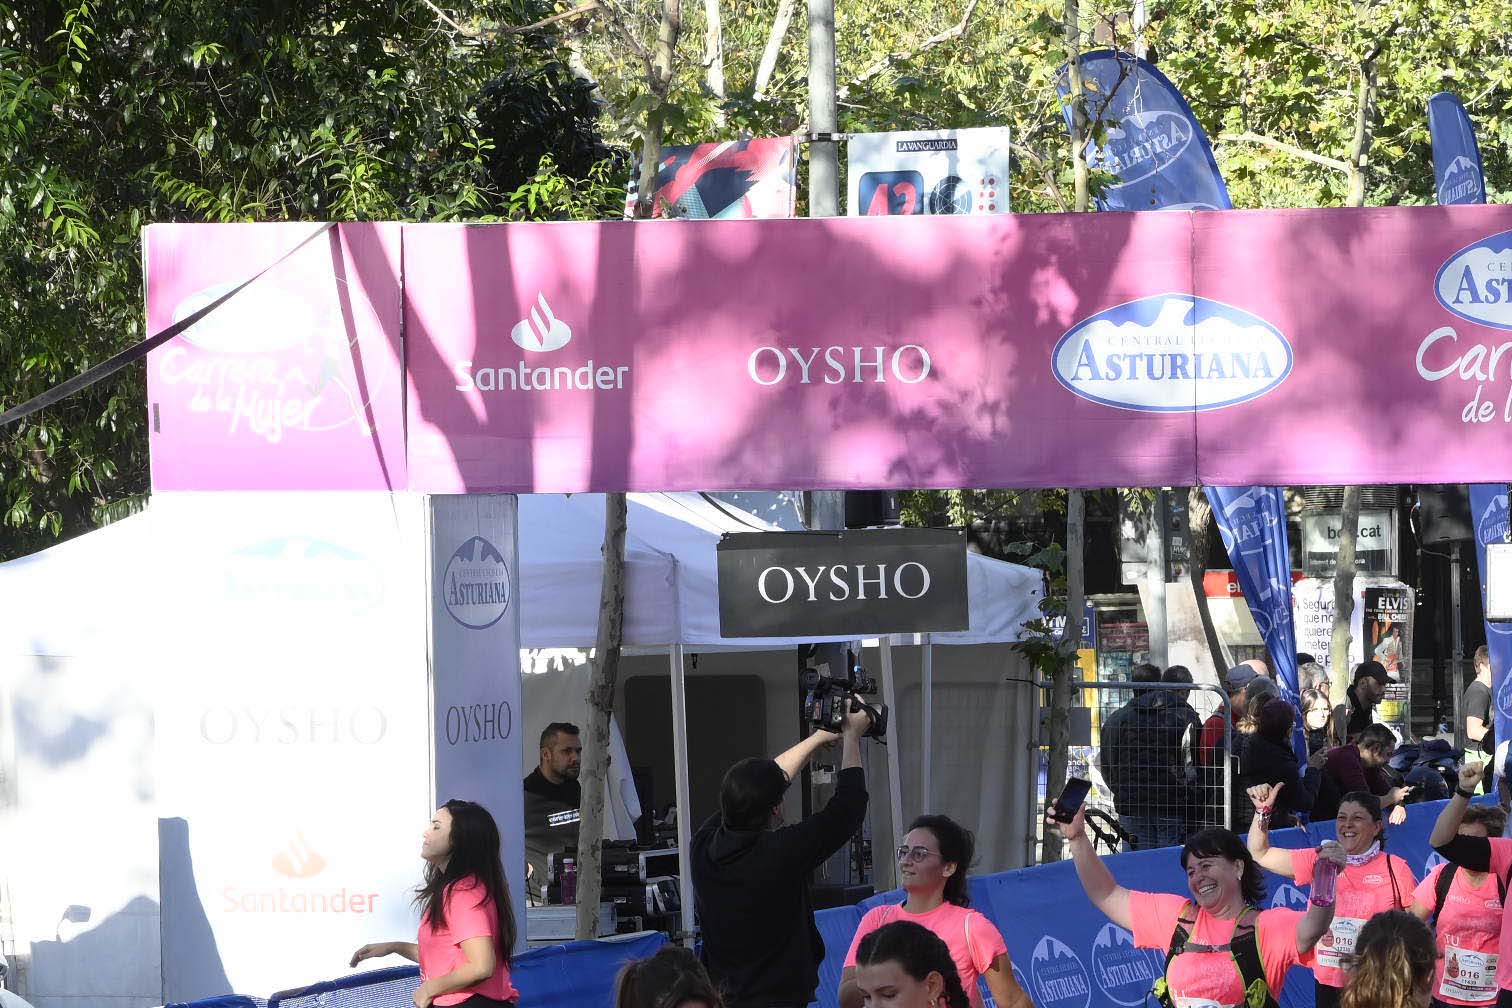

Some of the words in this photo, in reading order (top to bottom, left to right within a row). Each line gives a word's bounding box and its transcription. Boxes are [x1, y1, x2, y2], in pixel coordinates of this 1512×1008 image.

[747, 344, 932, 386] OYSHO
[1071, 337, 1277, 382] ASTURIANA
[455, 361, 630, 392] Santander
[1462, 385, 1496, 423] de
[1327, 524, 1382, 539] b.cat
[757, 561, 931, 604] OYSHO
[1378, 596, 1409, 610] ELVIS
[200, 705, 388, 745] OYSHO
[446, 701, 512, 746] OYSHO
[222, 885, 380, 915] Santander
[1335, 937, 1353, 946] 016
[1041, 971, 1088, 1003] ASTURIANA
[1101, 959, 1151, 988] ASTURIANA
[1460, 970, 1480, 980] 016
